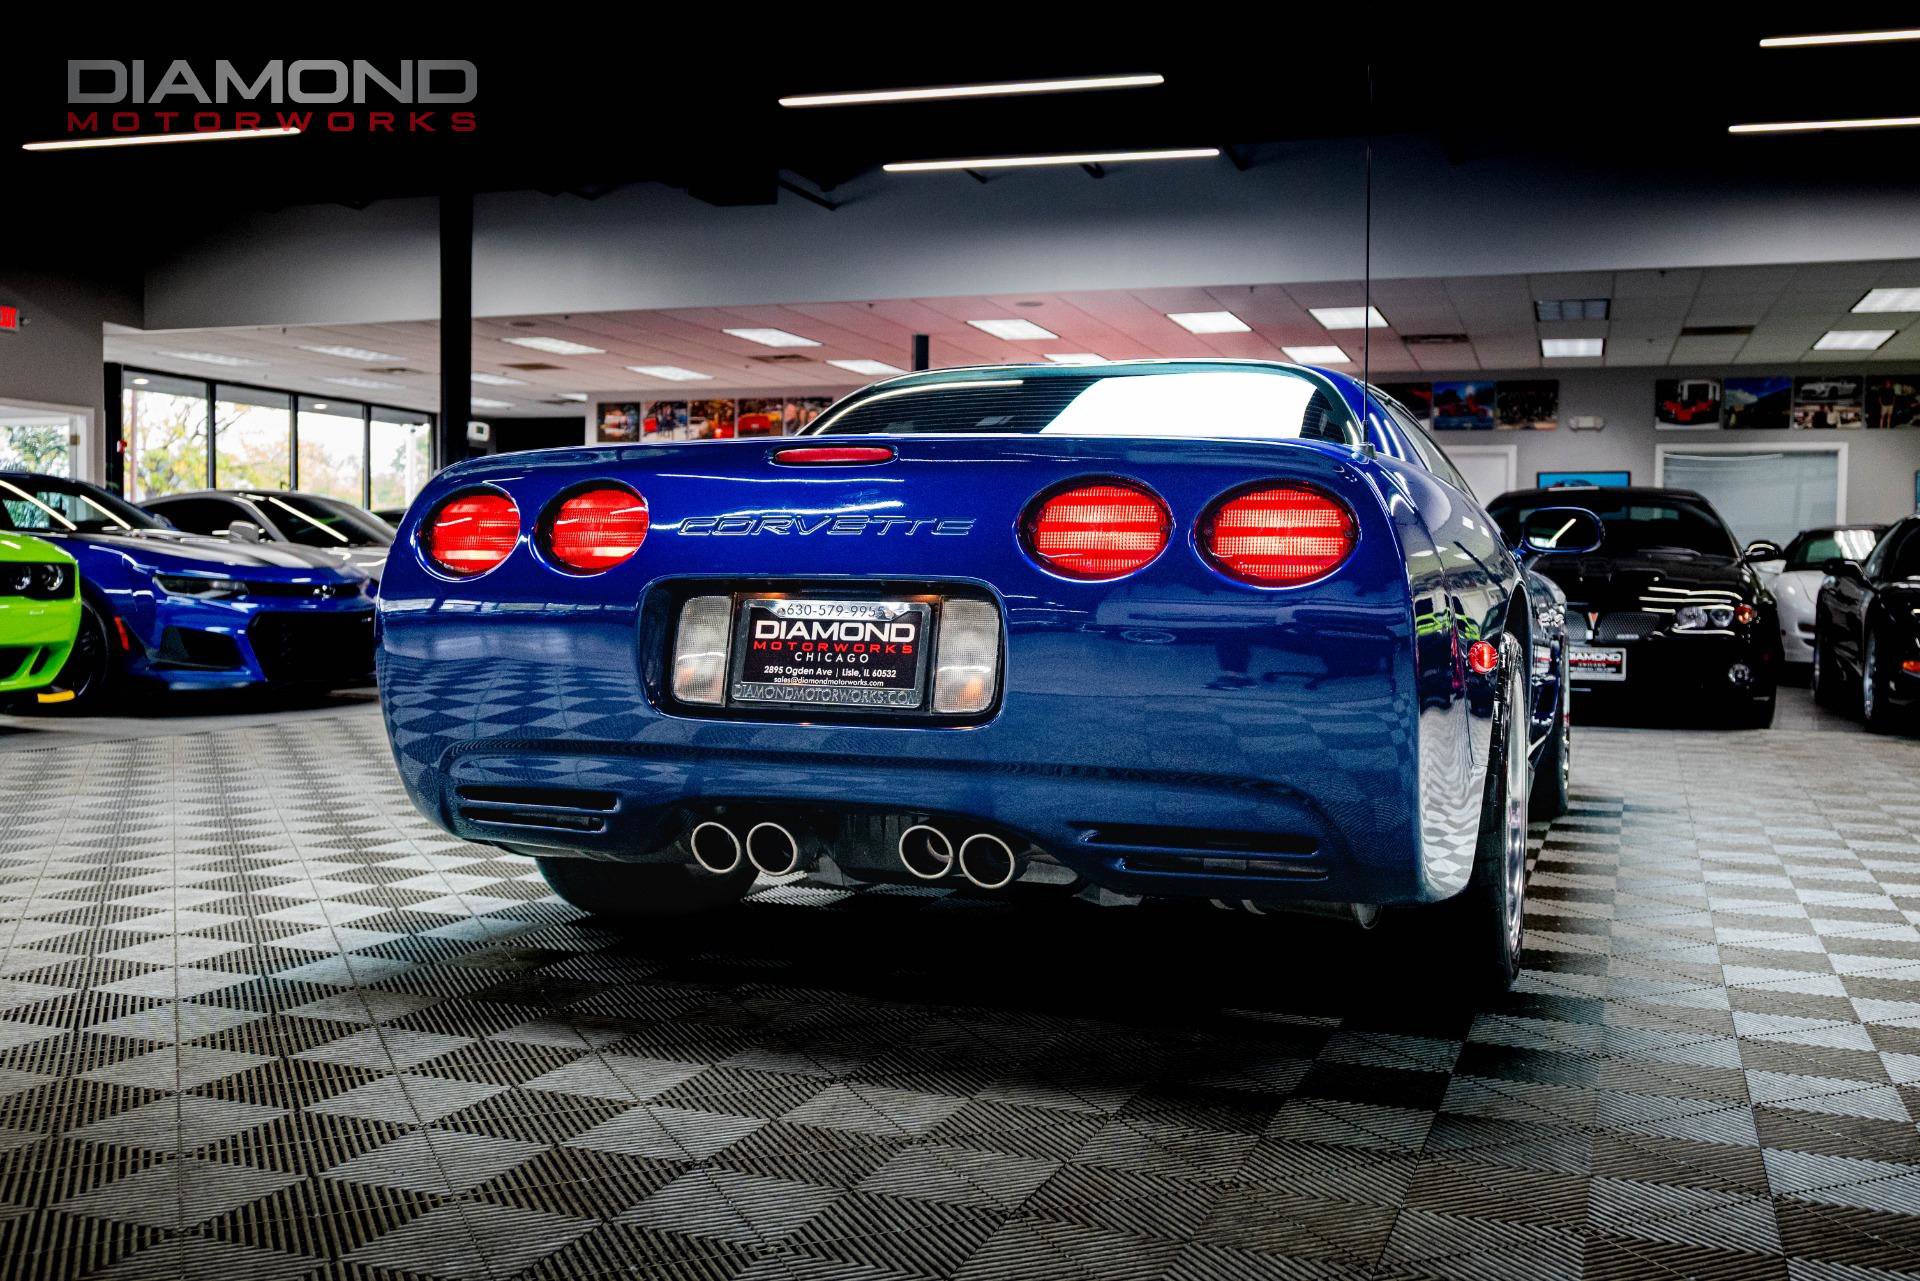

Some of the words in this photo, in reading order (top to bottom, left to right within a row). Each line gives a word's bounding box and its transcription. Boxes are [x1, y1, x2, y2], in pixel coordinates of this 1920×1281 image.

[678, 515, 977, 536] CORVETTE
[787, 604, 885, 617] 630-579-9955
[755, 621, 915, 642] DIAMOND
[753, 641, 912, 653] MOTORWORKS
[795, 652, 869, 662] CHICAGO
[764, 666, 784, 674] 2895
[785, 667, 814, 677] Ogden
[816, 668, 833, 676] Ave
[842, 669, 861, 678] Lisle,
[863, 669, 871, 677] IL
[872, 670, 897, 678] 60532
[774, 677, 884, 686] sales@diamondmotorworks.com
